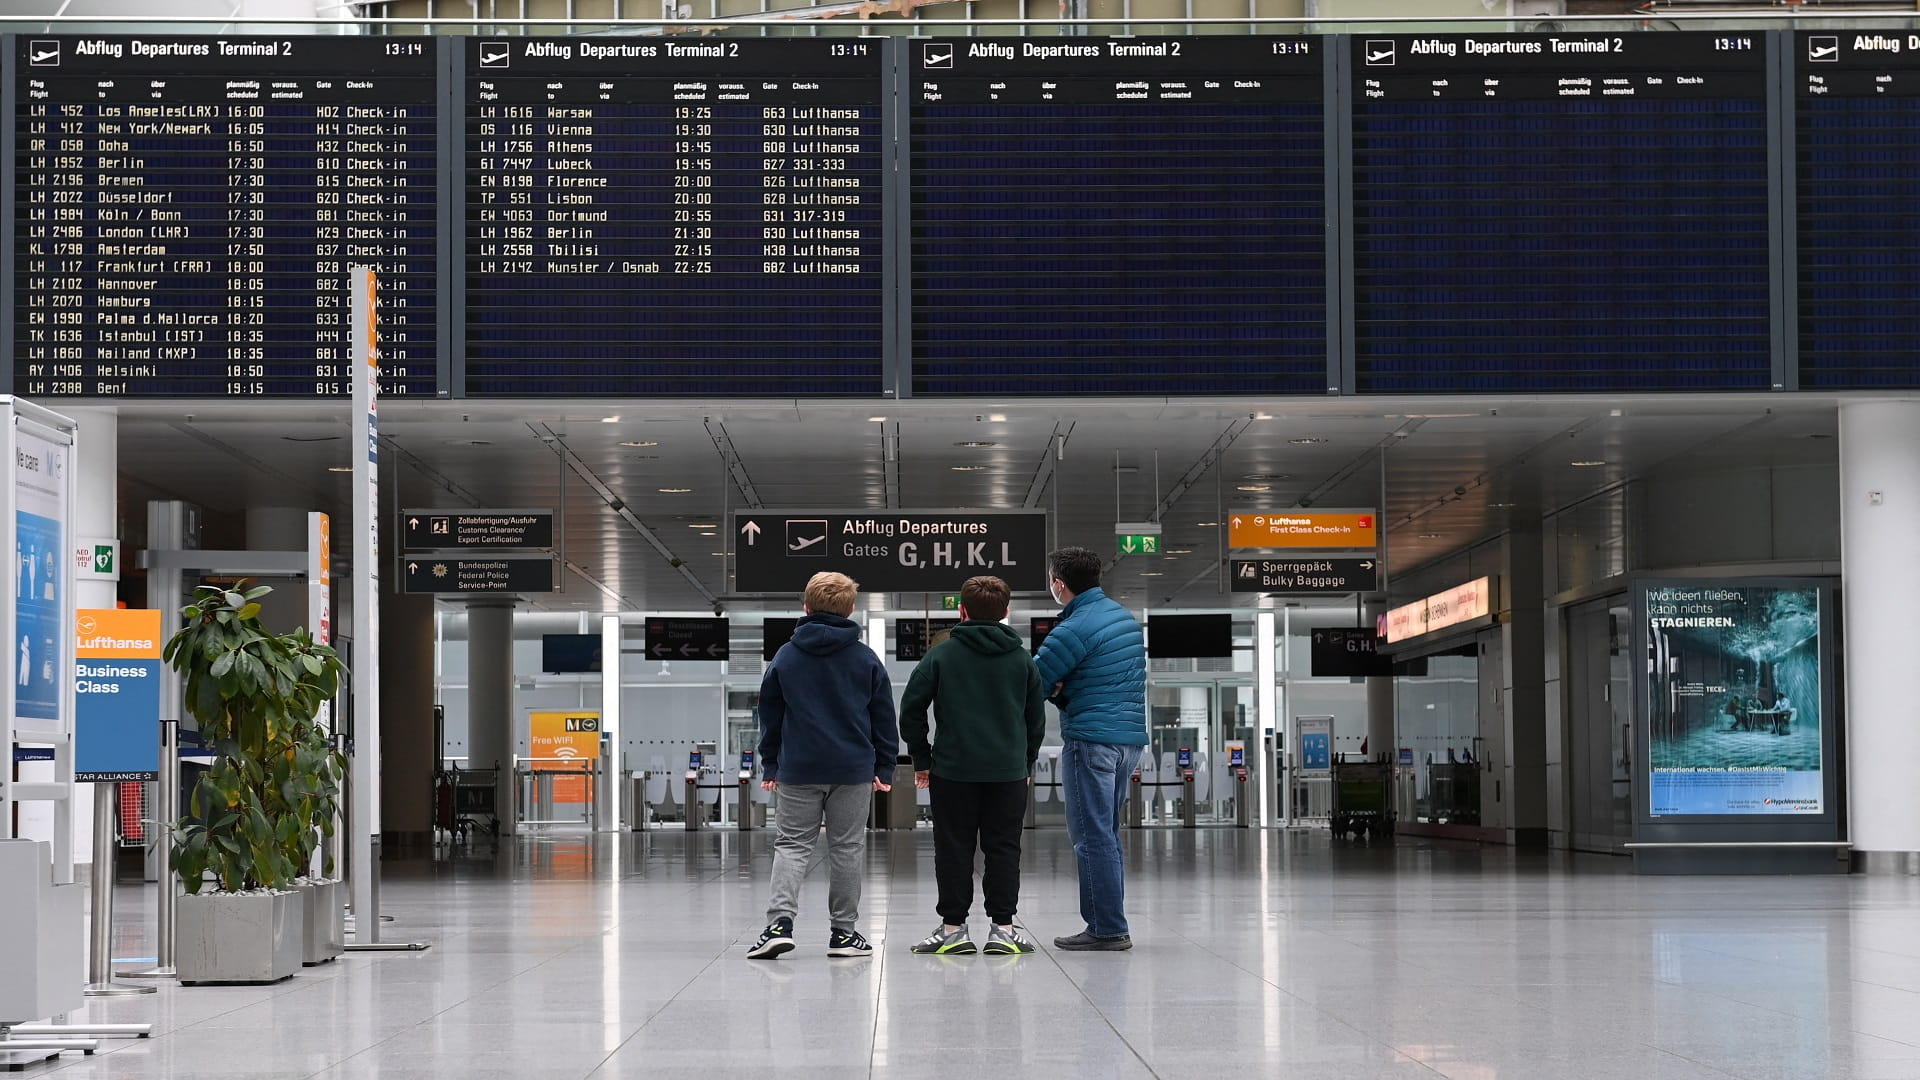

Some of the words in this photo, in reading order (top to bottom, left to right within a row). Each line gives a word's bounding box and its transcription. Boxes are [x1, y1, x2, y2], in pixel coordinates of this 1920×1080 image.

[76, 40, 122, 57] Abflug
[132, 41, 209, 58] Departures
[217, 41, 277, 55] Terminal
[283, 42, 291, 55] 2
[386, 44, 421, 54] 13:14
[1273, 43, 1308, 53] 13:14
[1411, 40, 1456, 56] Abflug
[1465, 40, 1541, 56] Departures
[1549, 38, 1608, 52] Terminal
[1614, 38, 1622, 52] 2
[1716, 39, 1750, 49] 13:14
[1854, 36, 1899, 52] Abflug
[525, 42, 571, 59] Abflug
[581, 43, 656, 59] Departures
[665, 43, 724, 56] Terminal
[730, 43, 738, 56] 2
[832, 45, 866, 55] 13:14
[969, 43, 1014, 59] Abflug
[1024, 43, 1099, 59] Departures
[1107, 42, 1166, 56] Terminal
[1172, 42, 1180, 55] 2
[30, 80, 44, 91] Flug
[30, 90, 48, 99] Flight
[924, 93, 941, 101] Flight
[31, 105, 45, 116] LH
[61, 105, 82, 116] 452
[99, 106, 120, 116] Los
[229, 106, 263, 117] 16:00
[317, 107, 338, 117] H02
[347, 107, 406, 117] Check-in
[31, 123, 45, 133] LH
[61, 123, 82, 133] 412
[99, 123, 120, 133] New
[130, 123, 210, 134] York/Newark
[229, 124, 263, 134] 16:05
[317, 124, 338, 134] H14
[347, 124, 406, 135] Check-in
[512, 124, 532, 135] 116
[548, 124, 592, 135] Vienna
[677, 125, 710, 135] 19:30
[794, 125, 859, 135] Lufthansa
[31, 157, 45, 168] LH
[55, 157, 82, 168] 1952
[99, 157, 143, 168] Berlin
[229, 158, 263, 169] 17:30
[348, 159, 406, 169] Check-in
[481, 210, 495, 221] EW
[504, 210, 532, 221] 4063
[548, 210, 606, 221] Dortmund
[675, 211, 711, 221] 20:55
[794, 211, 844, 221] 317-319
[31, 226, 44, 237] LH
[53, 226, 82, 237] 2486
[99, 227, 143, 237] London
[229, 227, 263, 238] 17:30
[317, 227, 338, 238] H29
[347, 228, 406, 238] Check-in
[481, 245, 495, 255] LH
[504, 245, 532, 255] 2558
[549, 245, 598, 255] Tbilisi
[675, 245, 711, 255] 22:15
[764, 245, 785, 255] H38
[794, 245, 859, 255] Lufthansa
[30, 296, 44, 306] LH
[53, 296, 82, 306] 2070
[98, 296, 150, 306] Hamburg
[229, 296, 263, 307] 18:15
[458, 517, 537, 525] Zollabfertigung/Ausfuhr
[1269, 518, 1310, 526] Lufthansa
[843, 520, 893, 536] Abflug
[900, 520, 987, 536] Departures
[1270, 526, 1288, 534] First
[1290, 526, 1312, 534] Class
[1314, 526, 1350, 534] Check-in
[844, 543, 888, 556] Gates
[899, 542, 926, 568] G,
[934, 542, 960, 568] H,
[968, 542, 994, 568] K,
[1002, 542, 1016, 565] L
[1262, 562, 1332, 572] Sperrgepäck
[1263, 576, 1293, 586] Bulky
[1297, 576, 1345, 587] Baggage
[1650, 592, 1668, 600] Wo
[1672, 592, 1700, 600] Ideen
[1705, 590, 1743, 601] fließen,
[1651, 604, 1677, 614] kann
[1681, 604, 1713, 613] nichts
[1651, 618, 1735, 627] STAGNIEREN.
[76, 636, 152, 648] Lufthansa
[76, 665, 147, 677] Business
[76, 681, 120, 693] Class
[566, 719, 580, 731] M
[532, 736, 552, 744] Free
